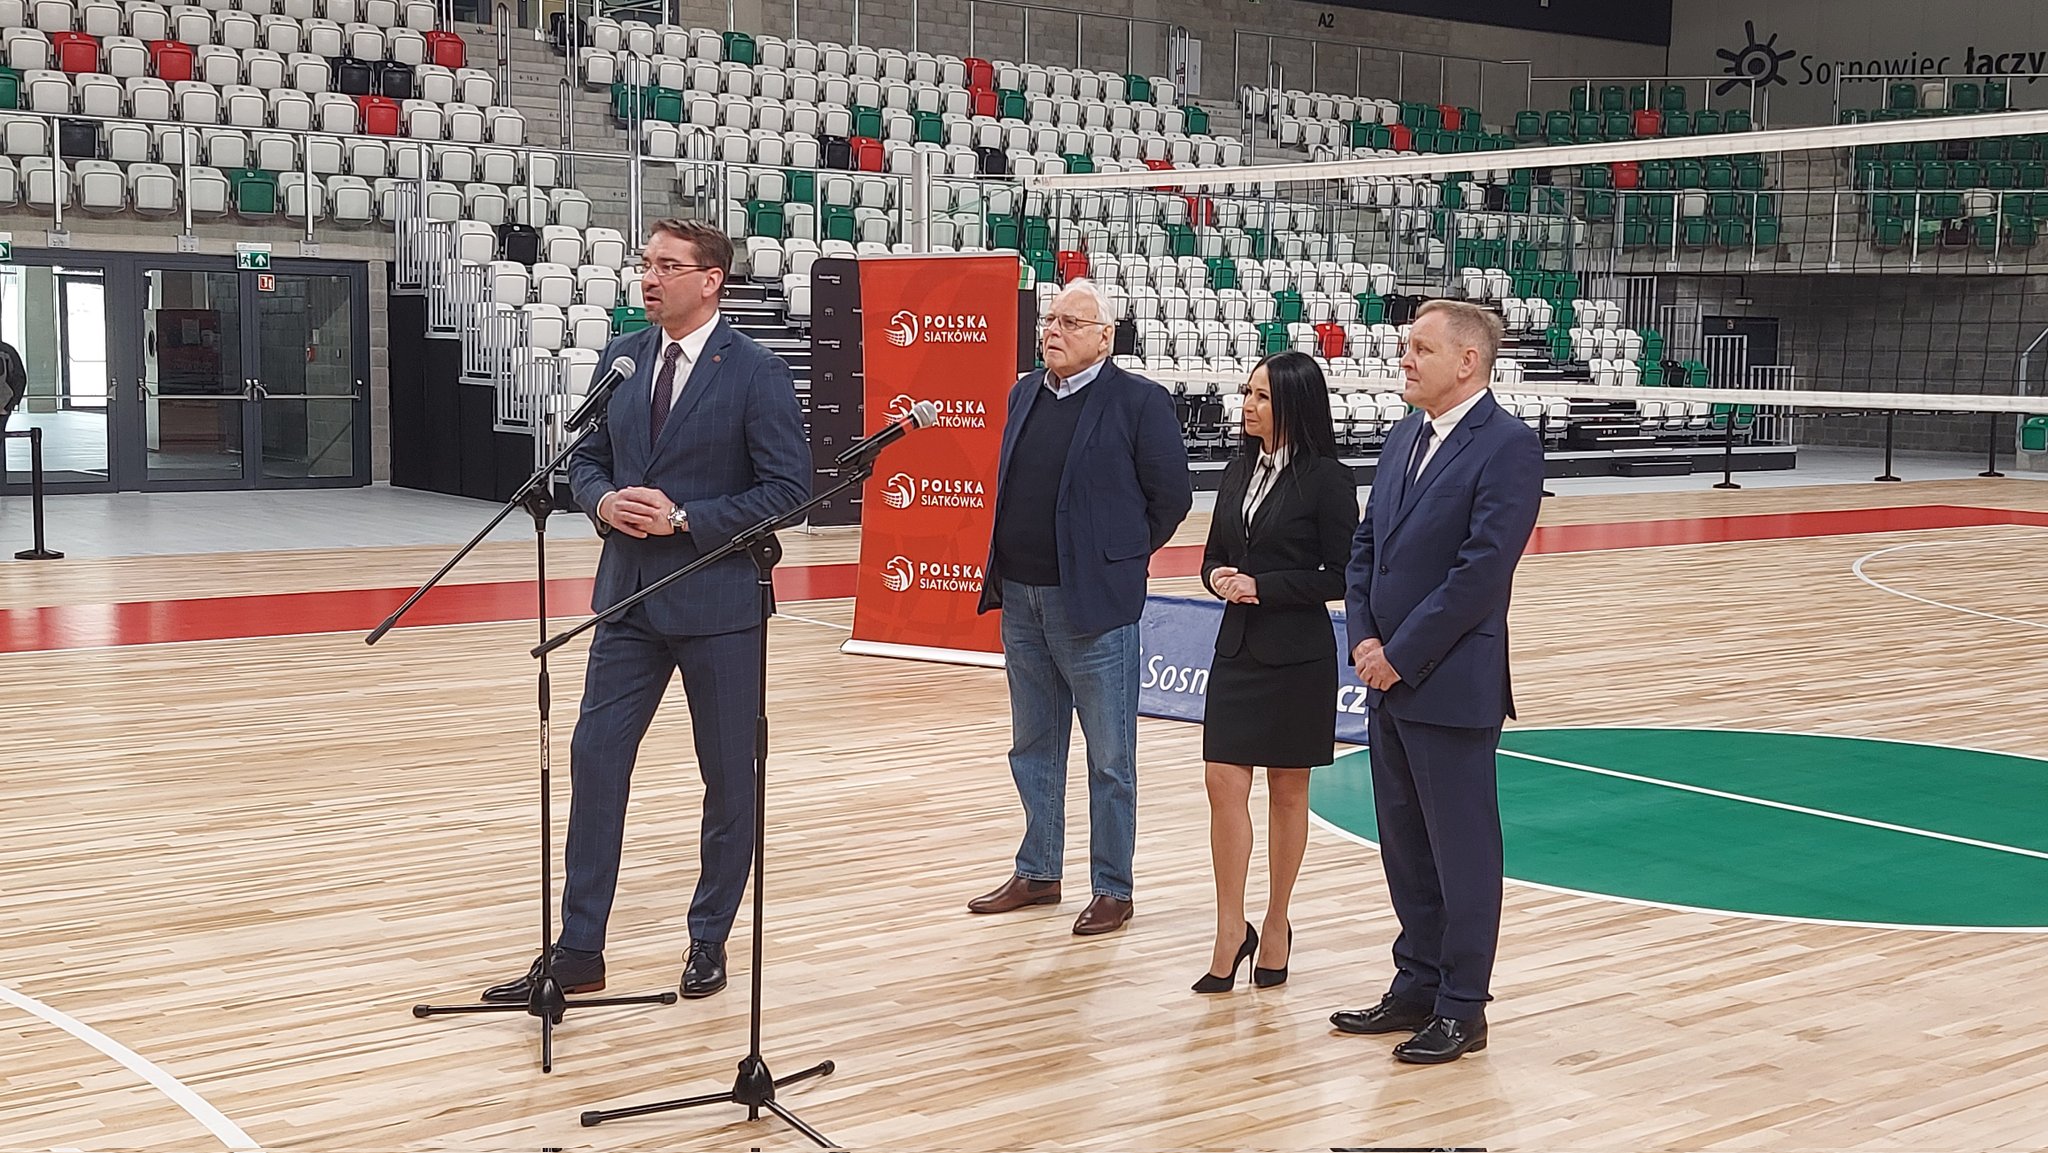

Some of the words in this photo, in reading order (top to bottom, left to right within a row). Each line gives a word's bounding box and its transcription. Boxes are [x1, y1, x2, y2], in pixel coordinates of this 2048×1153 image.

[1318, 12, 1335, 28] A2
[1964, 46, 2047, 84] łączy
[924, 314, 988, 329] POLSKA
[924, 328, 988, 343] SIATKÓWKA
[933, 399, 986, 414] OLSKA
[932, 413, 986, 428] ATKÓWKA
[921, 478, 984, 495] POLSKA
[921, 492, 984, 509] SIATKÓWKA
[920, 562, 983, 579] POLSKA
[920, 577, 983, 593] SIATKÓWKA
[1142, 655, 1209, 695] Sosn
